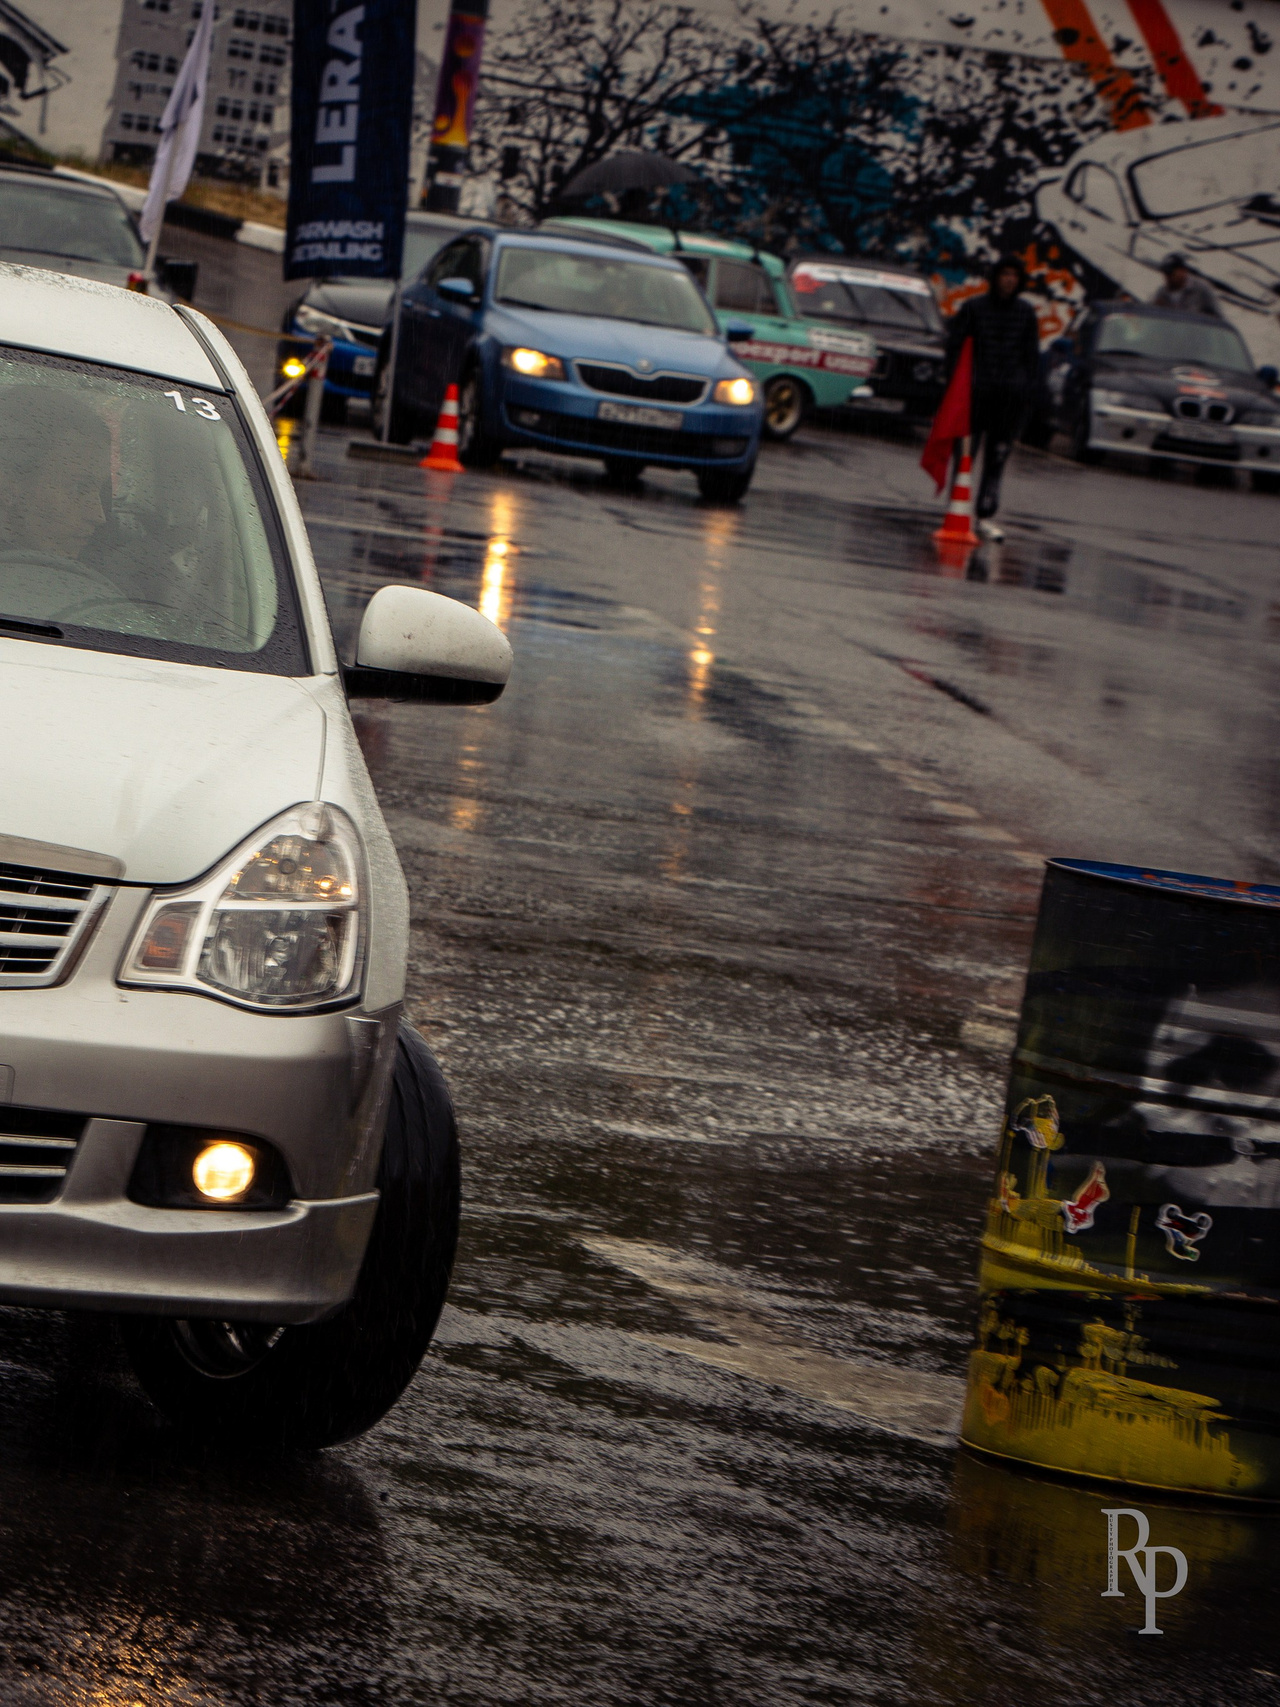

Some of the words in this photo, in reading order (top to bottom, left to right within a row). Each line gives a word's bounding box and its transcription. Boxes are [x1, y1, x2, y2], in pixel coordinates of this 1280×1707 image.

[310, 0, 366, 183] LERA
[295, 219, 385, 241] ARWASH
[291, 241, 384, 262] ETAILING
[163, 390, 222, 421] 13
